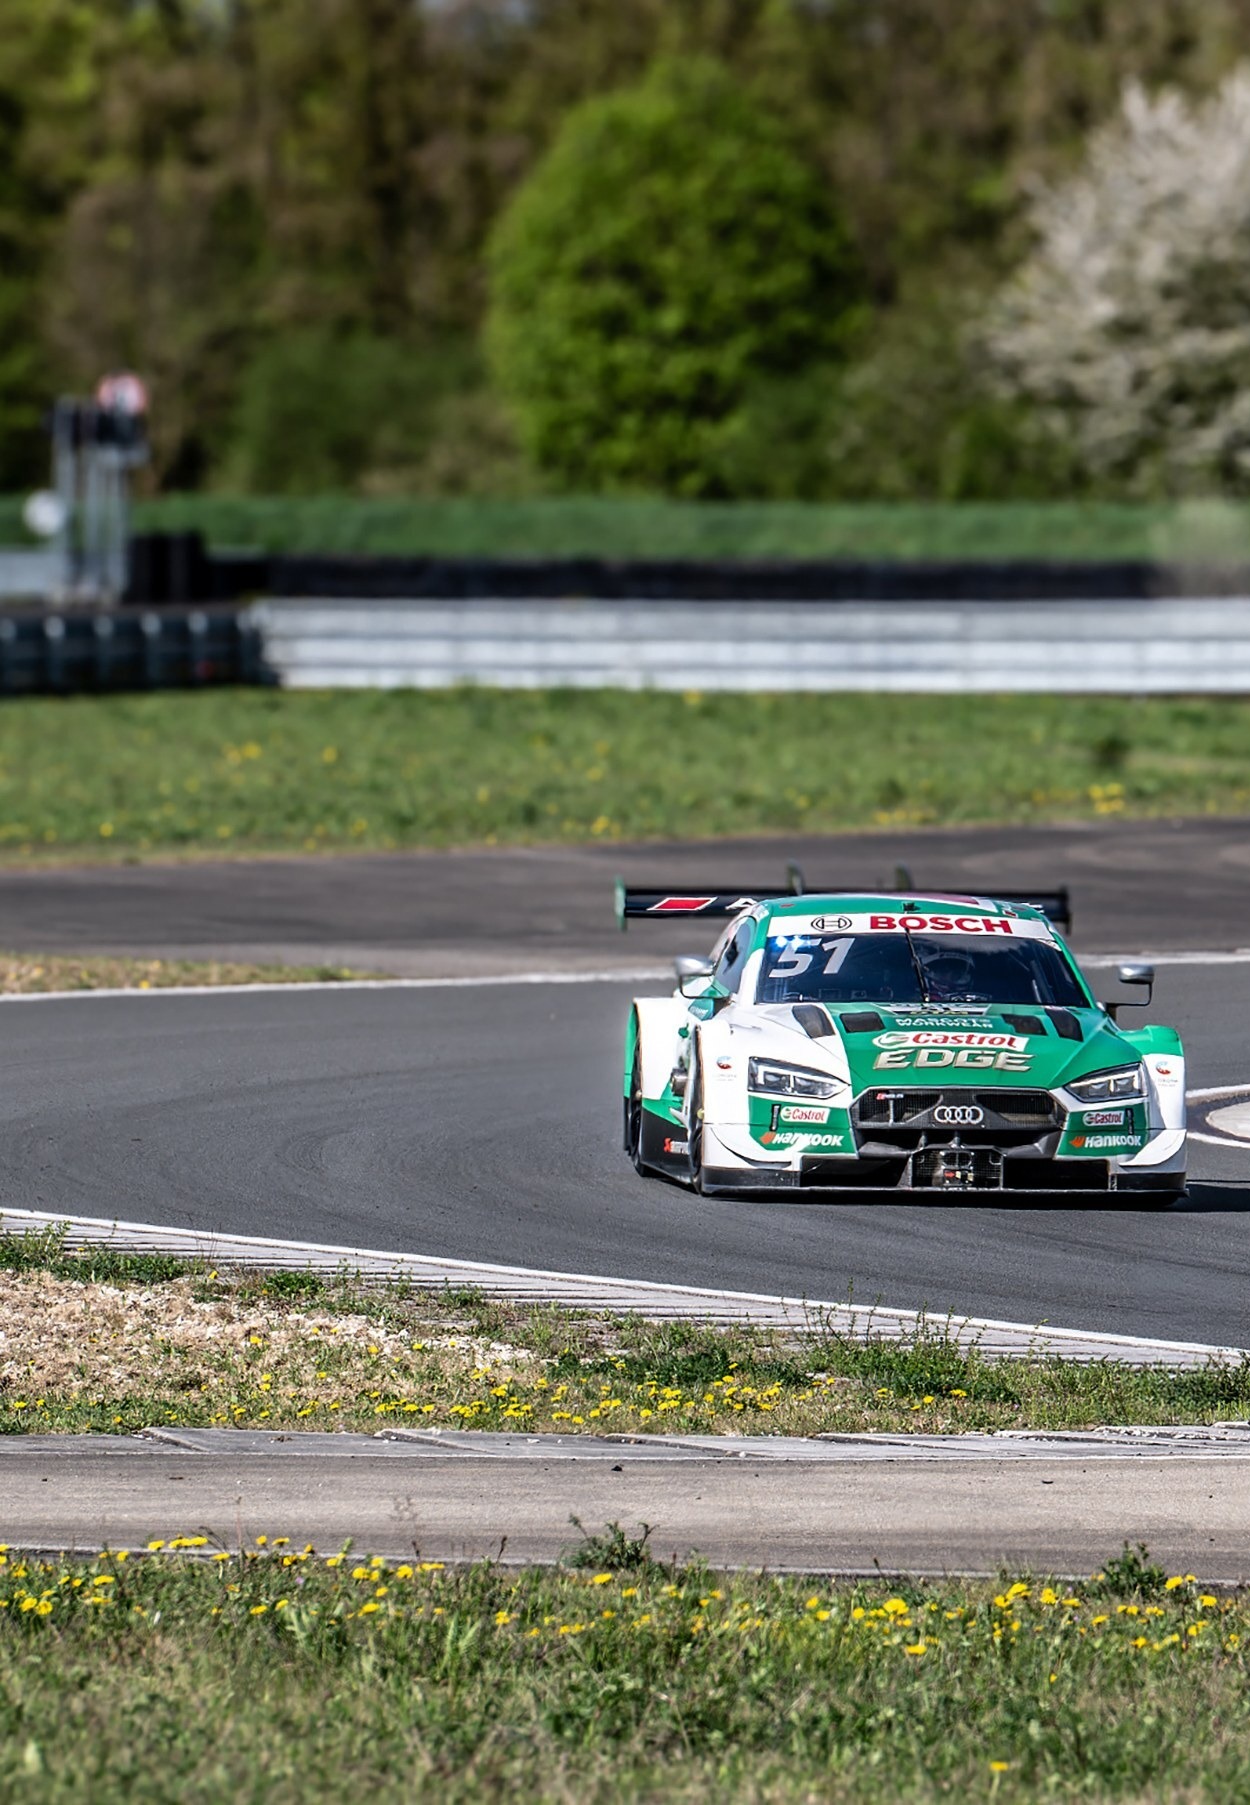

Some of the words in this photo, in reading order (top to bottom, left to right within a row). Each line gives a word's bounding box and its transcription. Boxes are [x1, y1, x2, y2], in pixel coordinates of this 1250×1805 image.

[869, 915, 1013, 934] BOSCH
[768, 937, 855, 978] 51
[912, 1032, 1017, 1049] Castrol
[872, 1049, 1035, 1072] EDGE
[791, 1108, 826, 1122] Castrol
[1094, 1113, 1122, 1122] Castrol
